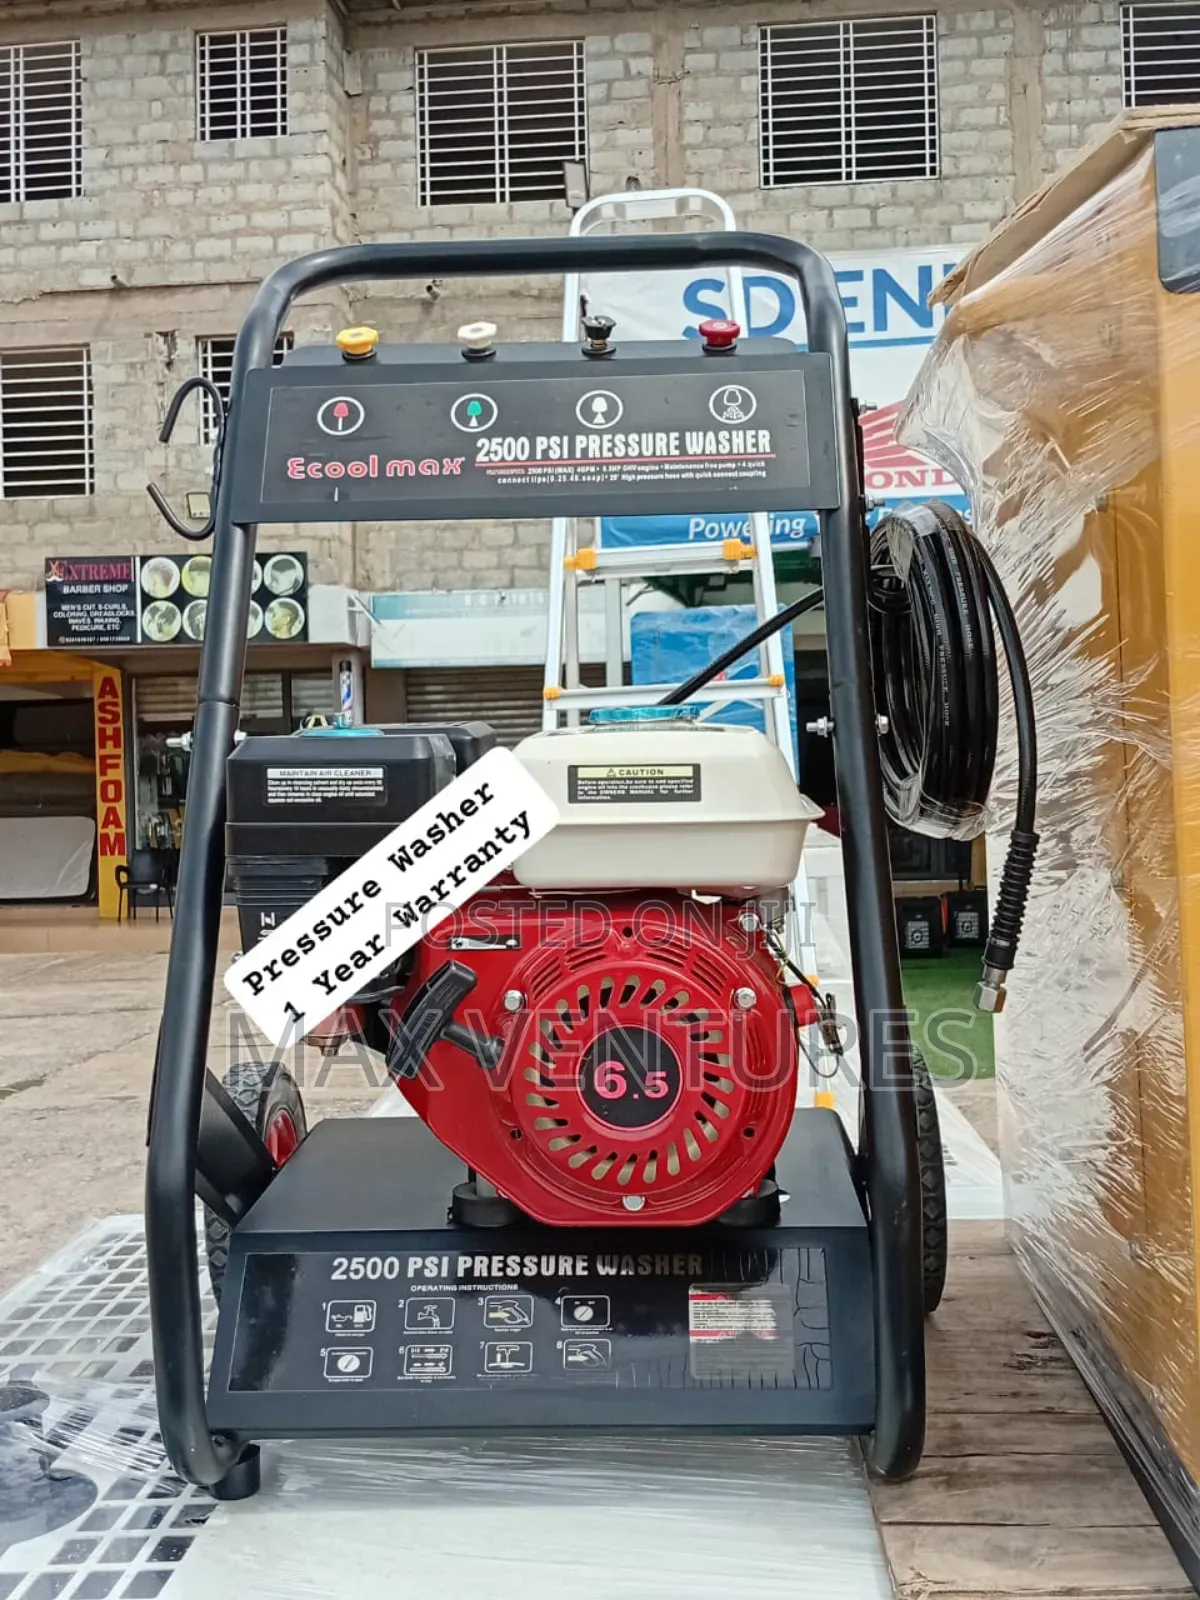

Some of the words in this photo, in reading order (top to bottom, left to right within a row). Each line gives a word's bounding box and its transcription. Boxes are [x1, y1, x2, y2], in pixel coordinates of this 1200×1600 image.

[475, 436, 530, 462] 2500
[535, 435, 569, 459] PSI
[575, 432, 680, 459] PRESSURE
[685, 429, 771, 455] WASHER
[287, 454, 379, 479] Ecool
[688, 516, 805, 541] Poweing
[63, 585, 101, 595] BARBER
[103, 584, 129, 594] SHOP
[280, 769, 317, 777] MAINTAIN
[319, 769, 332, 777] AIR
[618, 768, 664, 776] CAUTION
[594, 1060, 669, 1099] 6.5
[330, 1256, 400, 1280] 2500
[406, 1256, 449, 1278] PSI
[456, 1254, 589, 1277] PRESSURE
[596, 1254, 702, 1276] WASHER
[410, 1285, 457, 1293] OPERATING
[458, 1283, 519, 1292] INSTRUCTIONS
